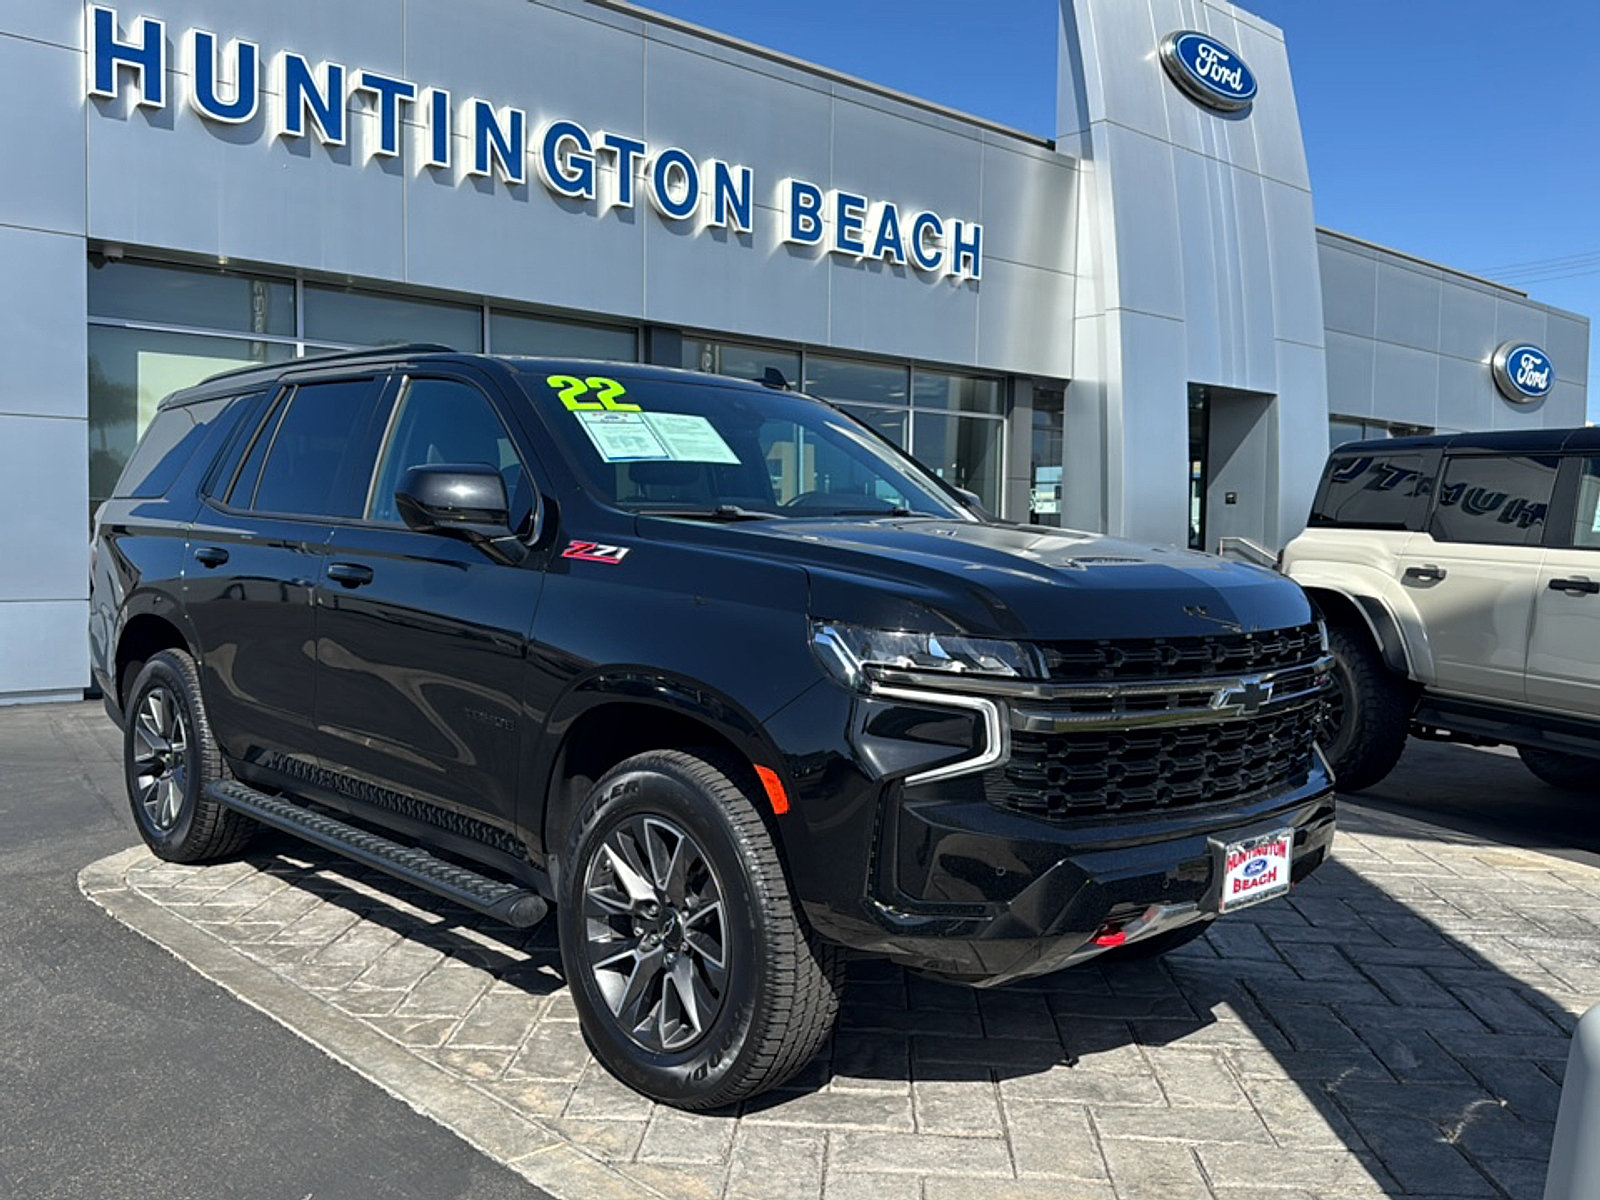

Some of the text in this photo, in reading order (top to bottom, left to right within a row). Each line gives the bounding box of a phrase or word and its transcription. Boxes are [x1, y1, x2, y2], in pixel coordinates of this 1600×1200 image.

[1195, 43, 1243, 91] Ford
[89, 5, 983, 280] HUNTINGTON BEACH
[1517, 353, 1549, 389] Ford
[546, 375, 641, 412] 22
[562, 540, 629, 564] Z71
[1233, 866, 1277, 894] BEACH
